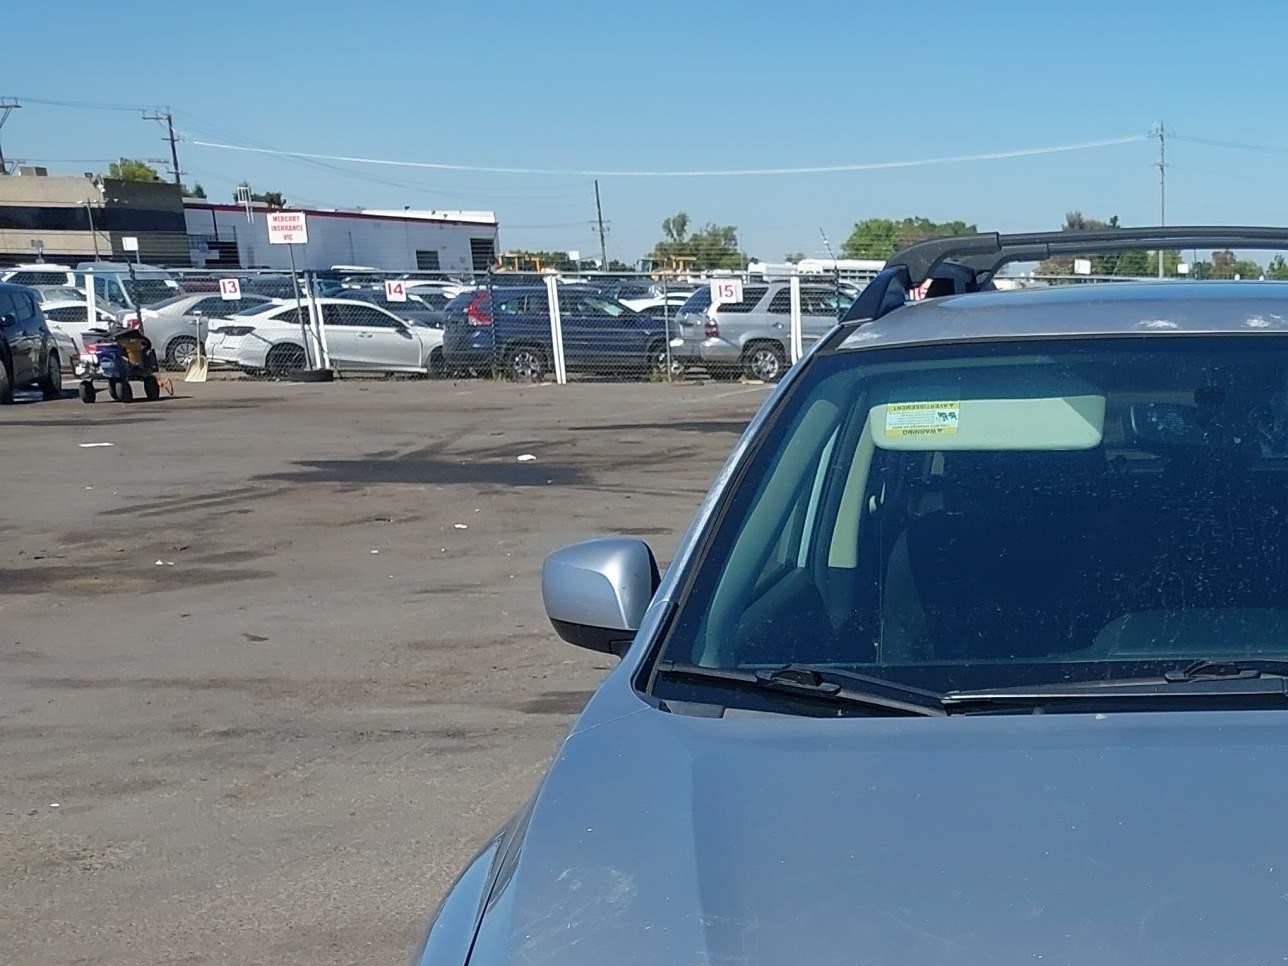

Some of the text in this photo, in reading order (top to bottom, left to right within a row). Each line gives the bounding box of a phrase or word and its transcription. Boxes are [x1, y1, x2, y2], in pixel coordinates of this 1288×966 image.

[221, 281, 238, 294] 13
[387, 282, 403, 296] 14
[718, 284, 734, 298] 15
